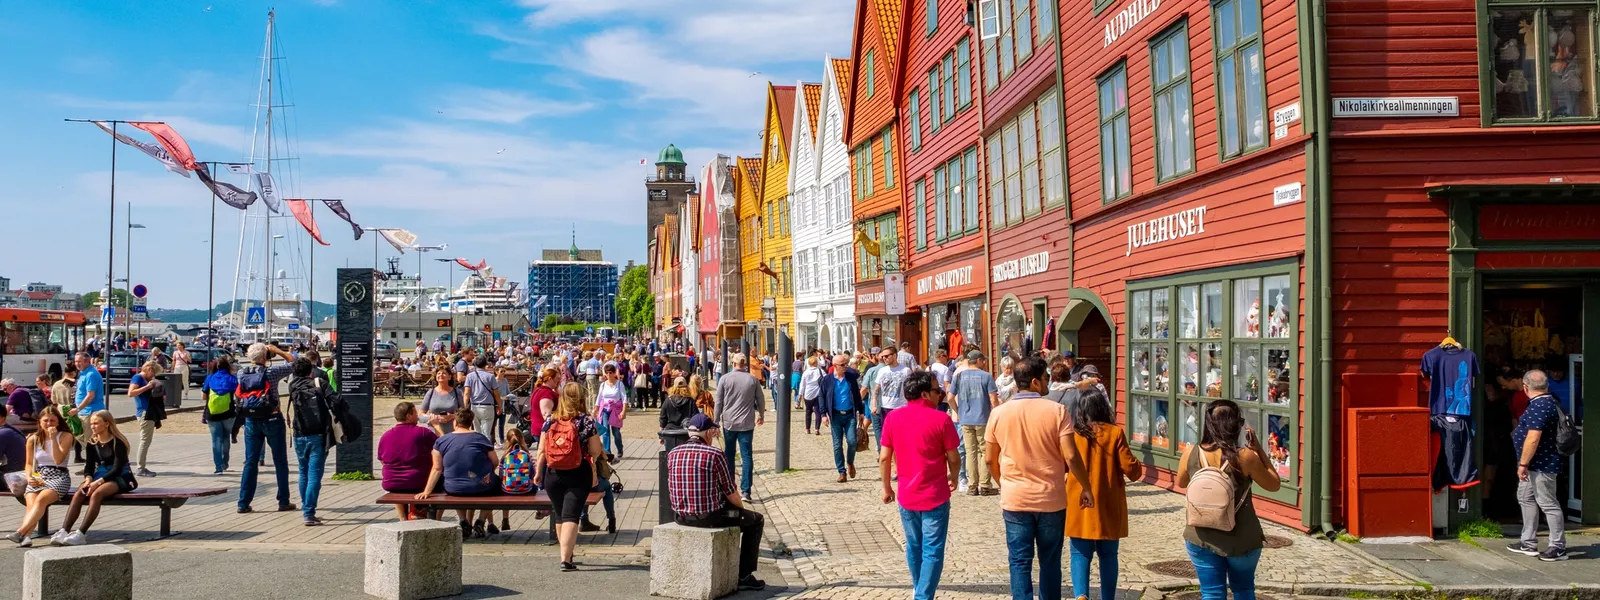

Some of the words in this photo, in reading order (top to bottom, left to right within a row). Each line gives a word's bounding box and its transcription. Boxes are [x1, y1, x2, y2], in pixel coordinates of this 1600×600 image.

[1104, 0, 1161, 48] AUDHILD
[1276, 108, 1296, 123] Bryggen
[1339, 99, 1453, 113] Nikolaikirkeallmenningen
[1126, 206, 1207, 257] JULEHUSET
[917, 276, 933, 295] KNUT
[935, 265, 973, 290] SKURTVEIT
